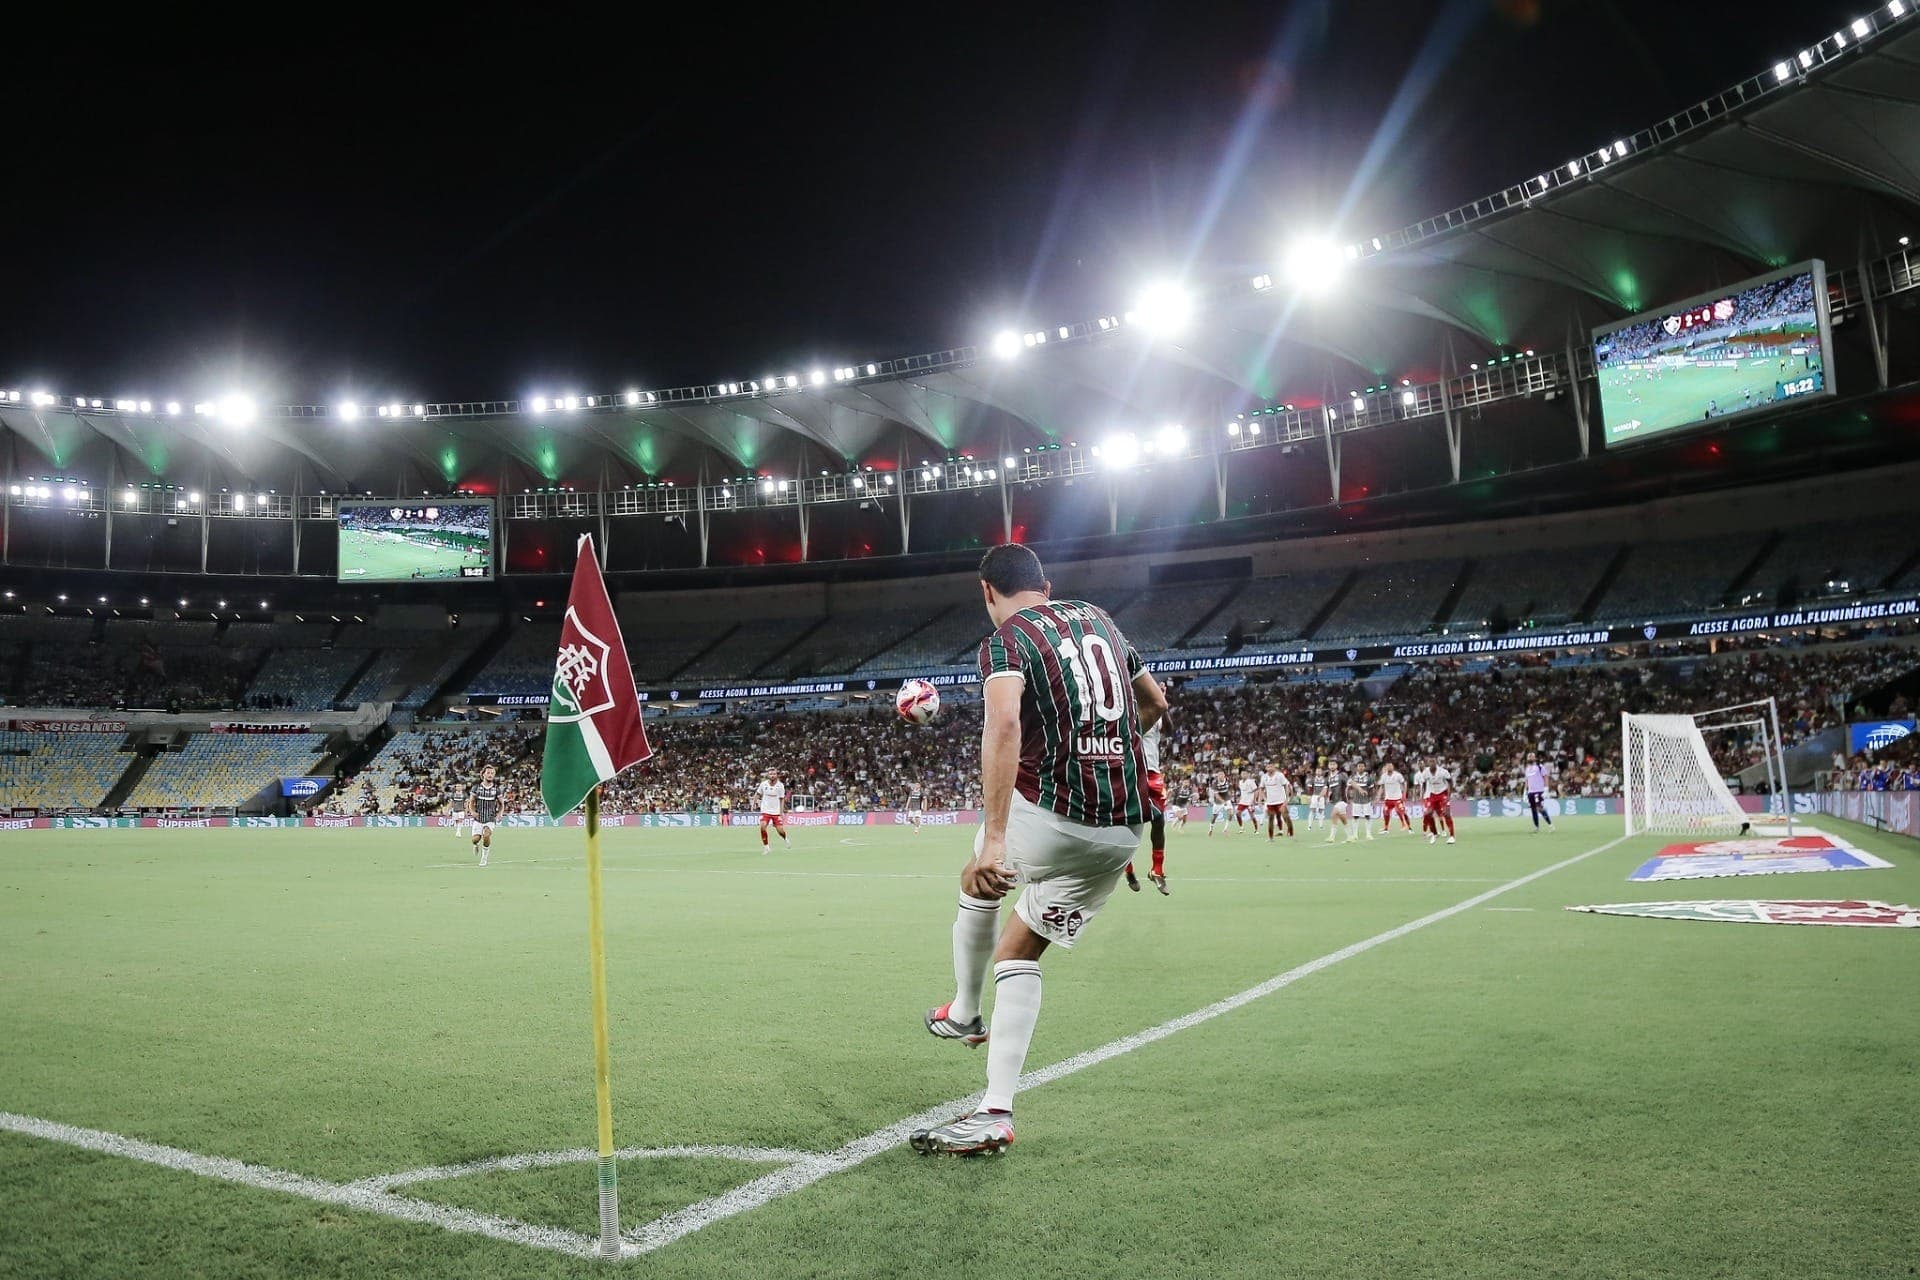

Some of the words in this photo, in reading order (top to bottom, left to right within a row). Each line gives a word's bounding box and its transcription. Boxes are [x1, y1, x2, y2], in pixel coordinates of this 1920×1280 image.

[1783, 378, 1814, 395] 15:22
[1690, 621, 1729, 635] ACESSE
[1731, 617, 1769, 631] AGORA
[1394, 645, 1429, 657] ACESSE
[1431, 642, 1464, 654] AGORA
[1467, 631, 1610, 652] LOJA.FLUMINENSE.COM.BR
[1157, 661, 1187, 671] AGORA
[1190, 653, 1314, 670] LOJA.FLUMINENSE.COM.BR
[930, 675, 955, 685] AGORA
[1058, 633, 1125, 722] 10
[699, 690, 724, 698] ACESSE
[725, 688, 749, 697] AGORA
[750, 682, 844, 696] LOJA.FLUMINENSE.COM.BR
[497, 696, 523, 704] ACESSE
[524, 696, 549, 704] AGORA
[1077, 737, 1124, 755] UNIG
[156, 818, 212, 828] SUPERBET
[314, 817, 354, 828] SUPERBET
[577, 815, 626, 827] SRBET
[787, 815, 833, 826] SUPERBET
[838, 814, 864, 825] 2026
[895, 812, 959, 825] SUERBET
